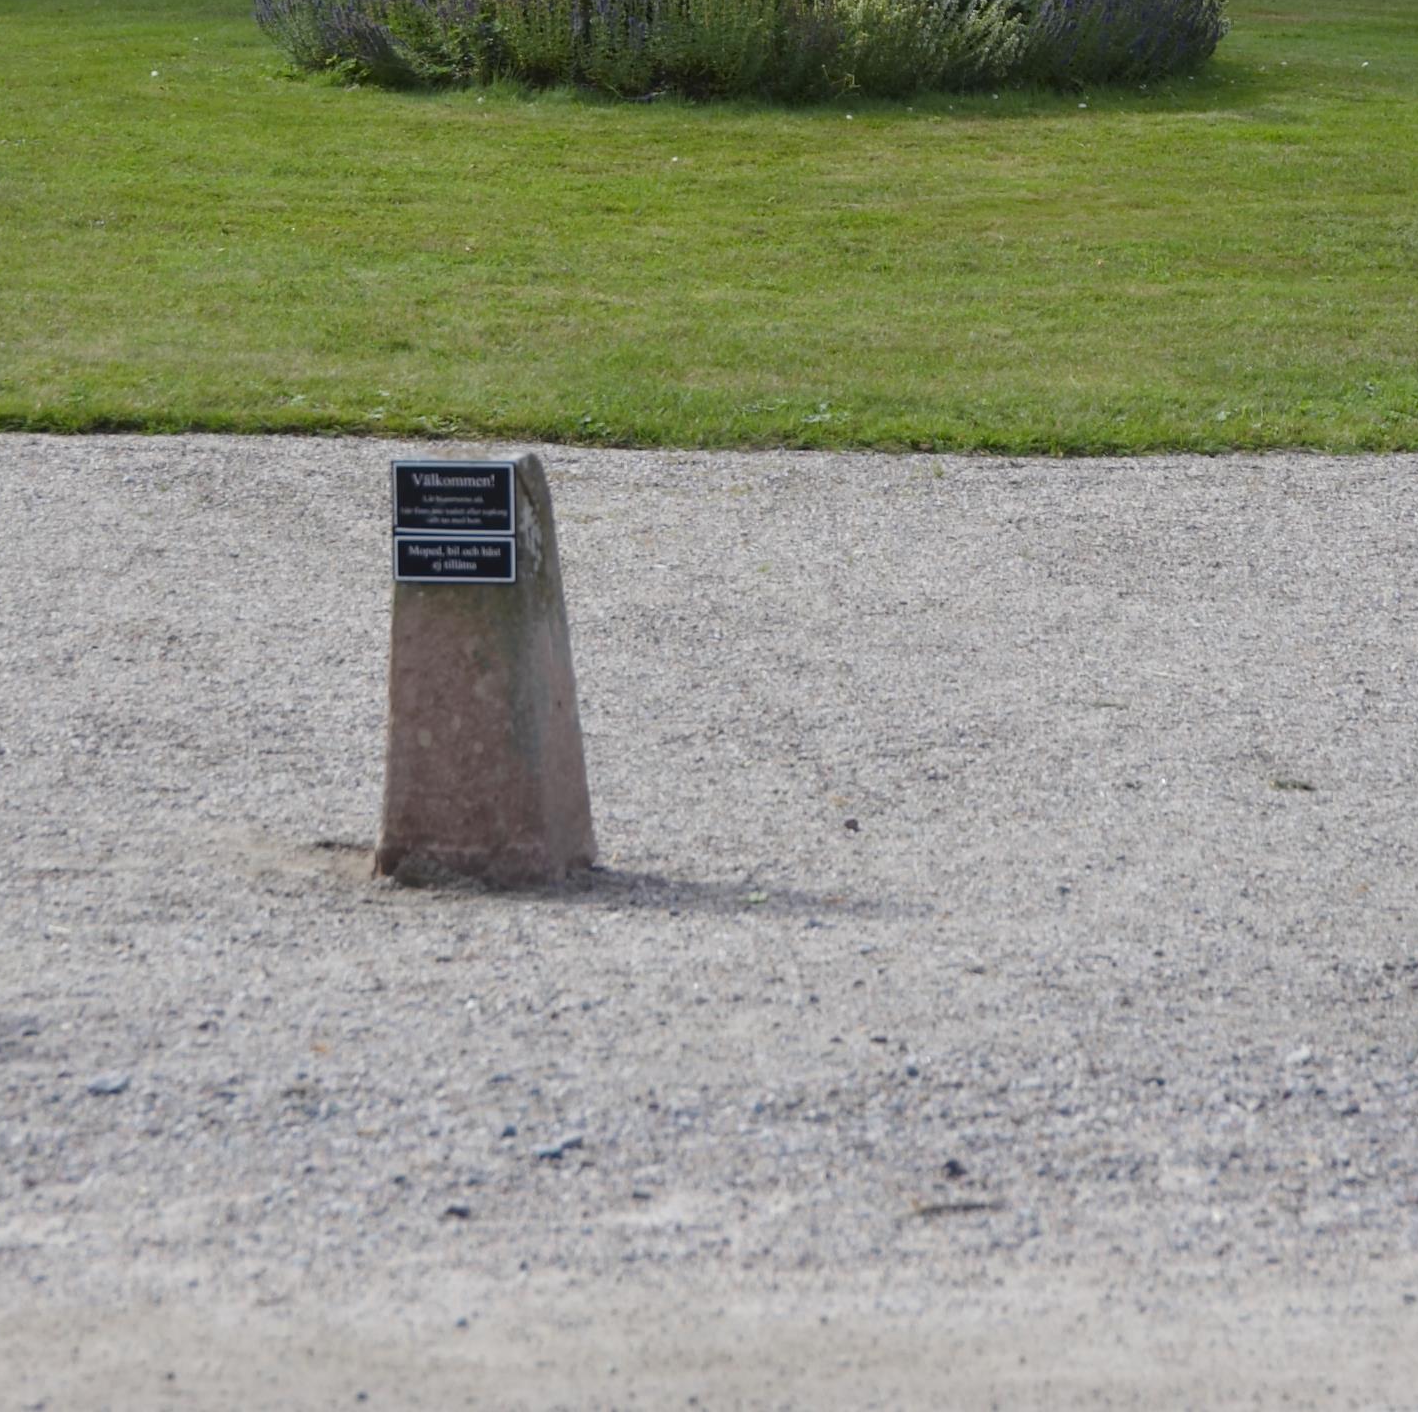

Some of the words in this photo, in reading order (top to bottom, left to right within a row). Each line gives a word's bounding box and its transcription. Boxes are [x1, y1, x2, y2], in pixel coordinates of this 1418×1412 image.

[412, 473, 496, 487] Välkommen!
[408, 545, 445, 559] Moped,
[447, 545, 460, 556] bil
[462, 545, 479, 556] och
[432, 559, 442, 572] ej
